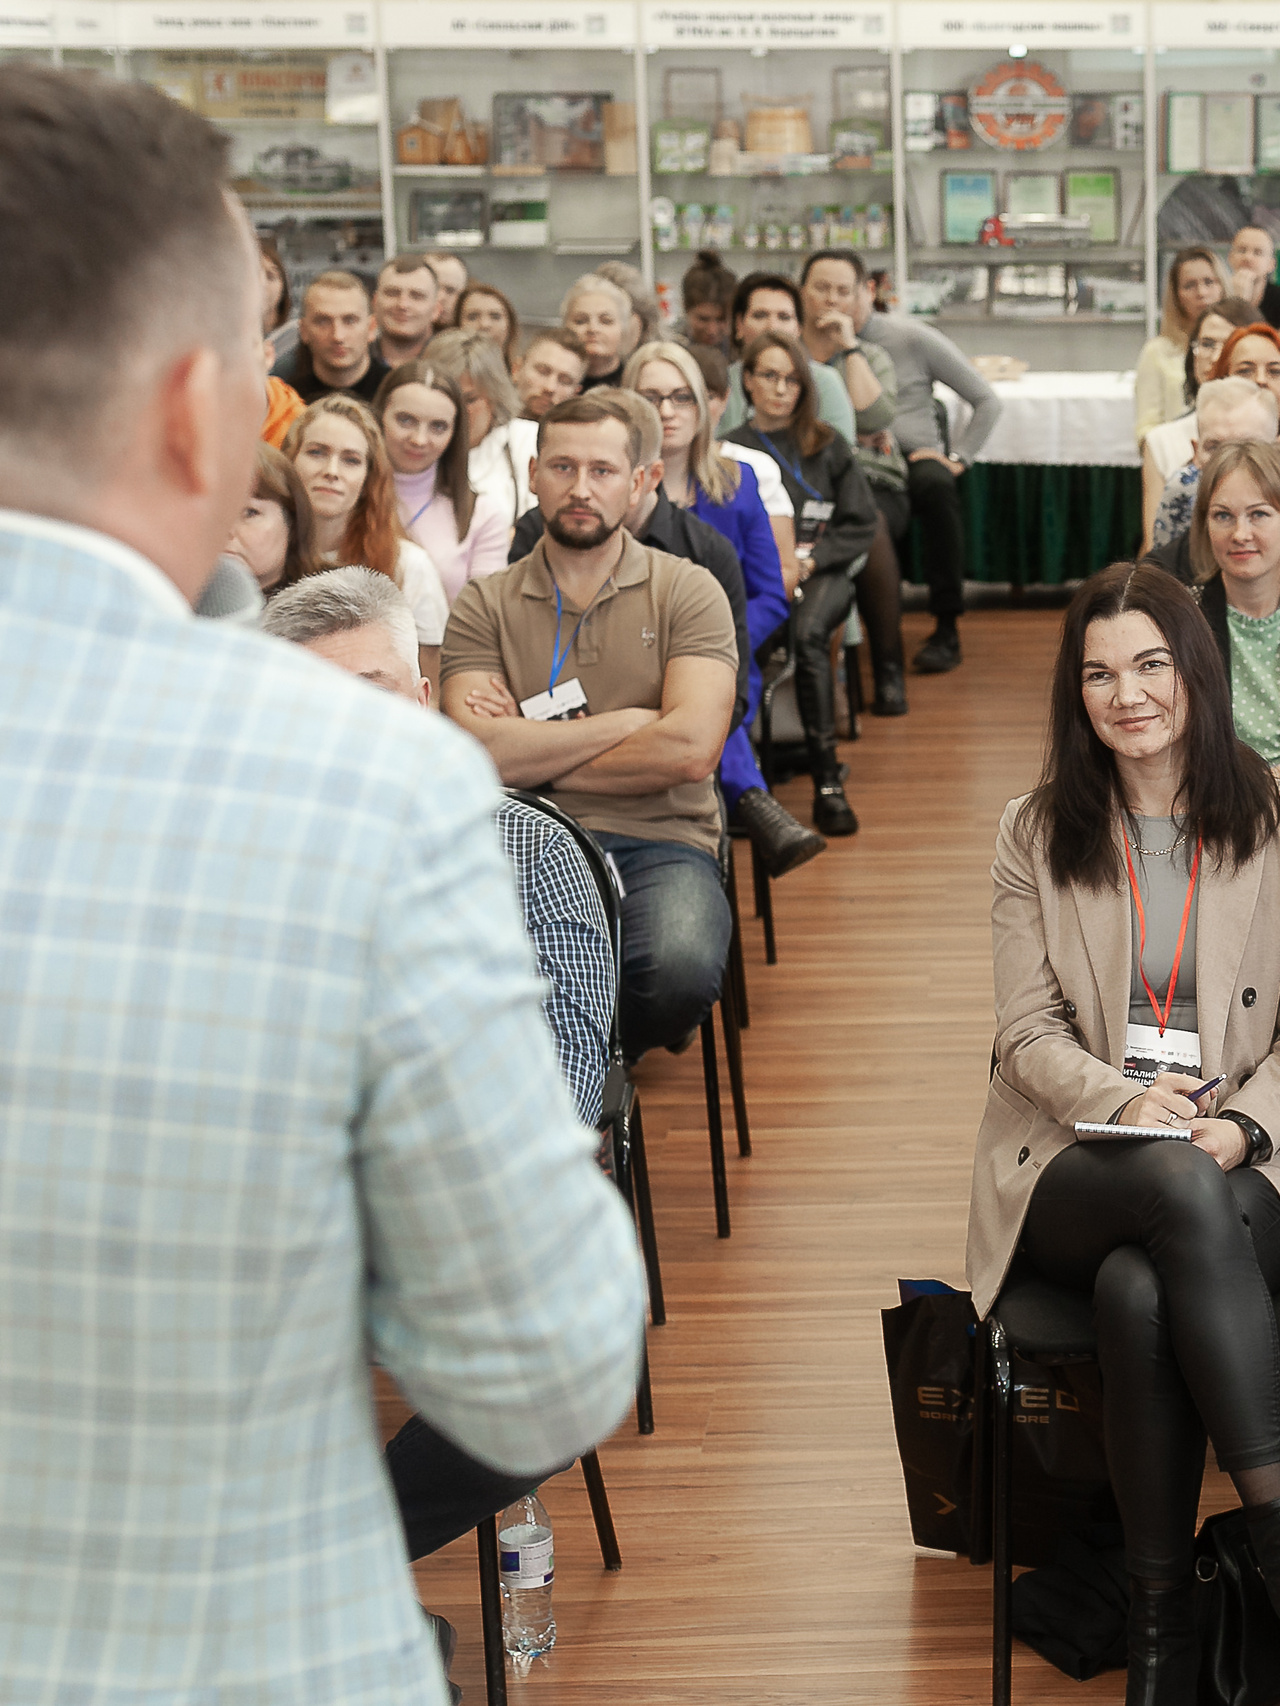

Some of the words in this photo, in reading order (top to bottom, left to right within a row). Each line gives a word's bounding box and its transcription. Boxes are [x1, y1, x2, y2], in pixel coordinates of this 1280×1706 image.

[1123, 1069, 1157, 1080] ИТАЛИЙ
[917, 1386, 1081, 1412] EXED
[1013, 1414, 1050, 1424] ORE
